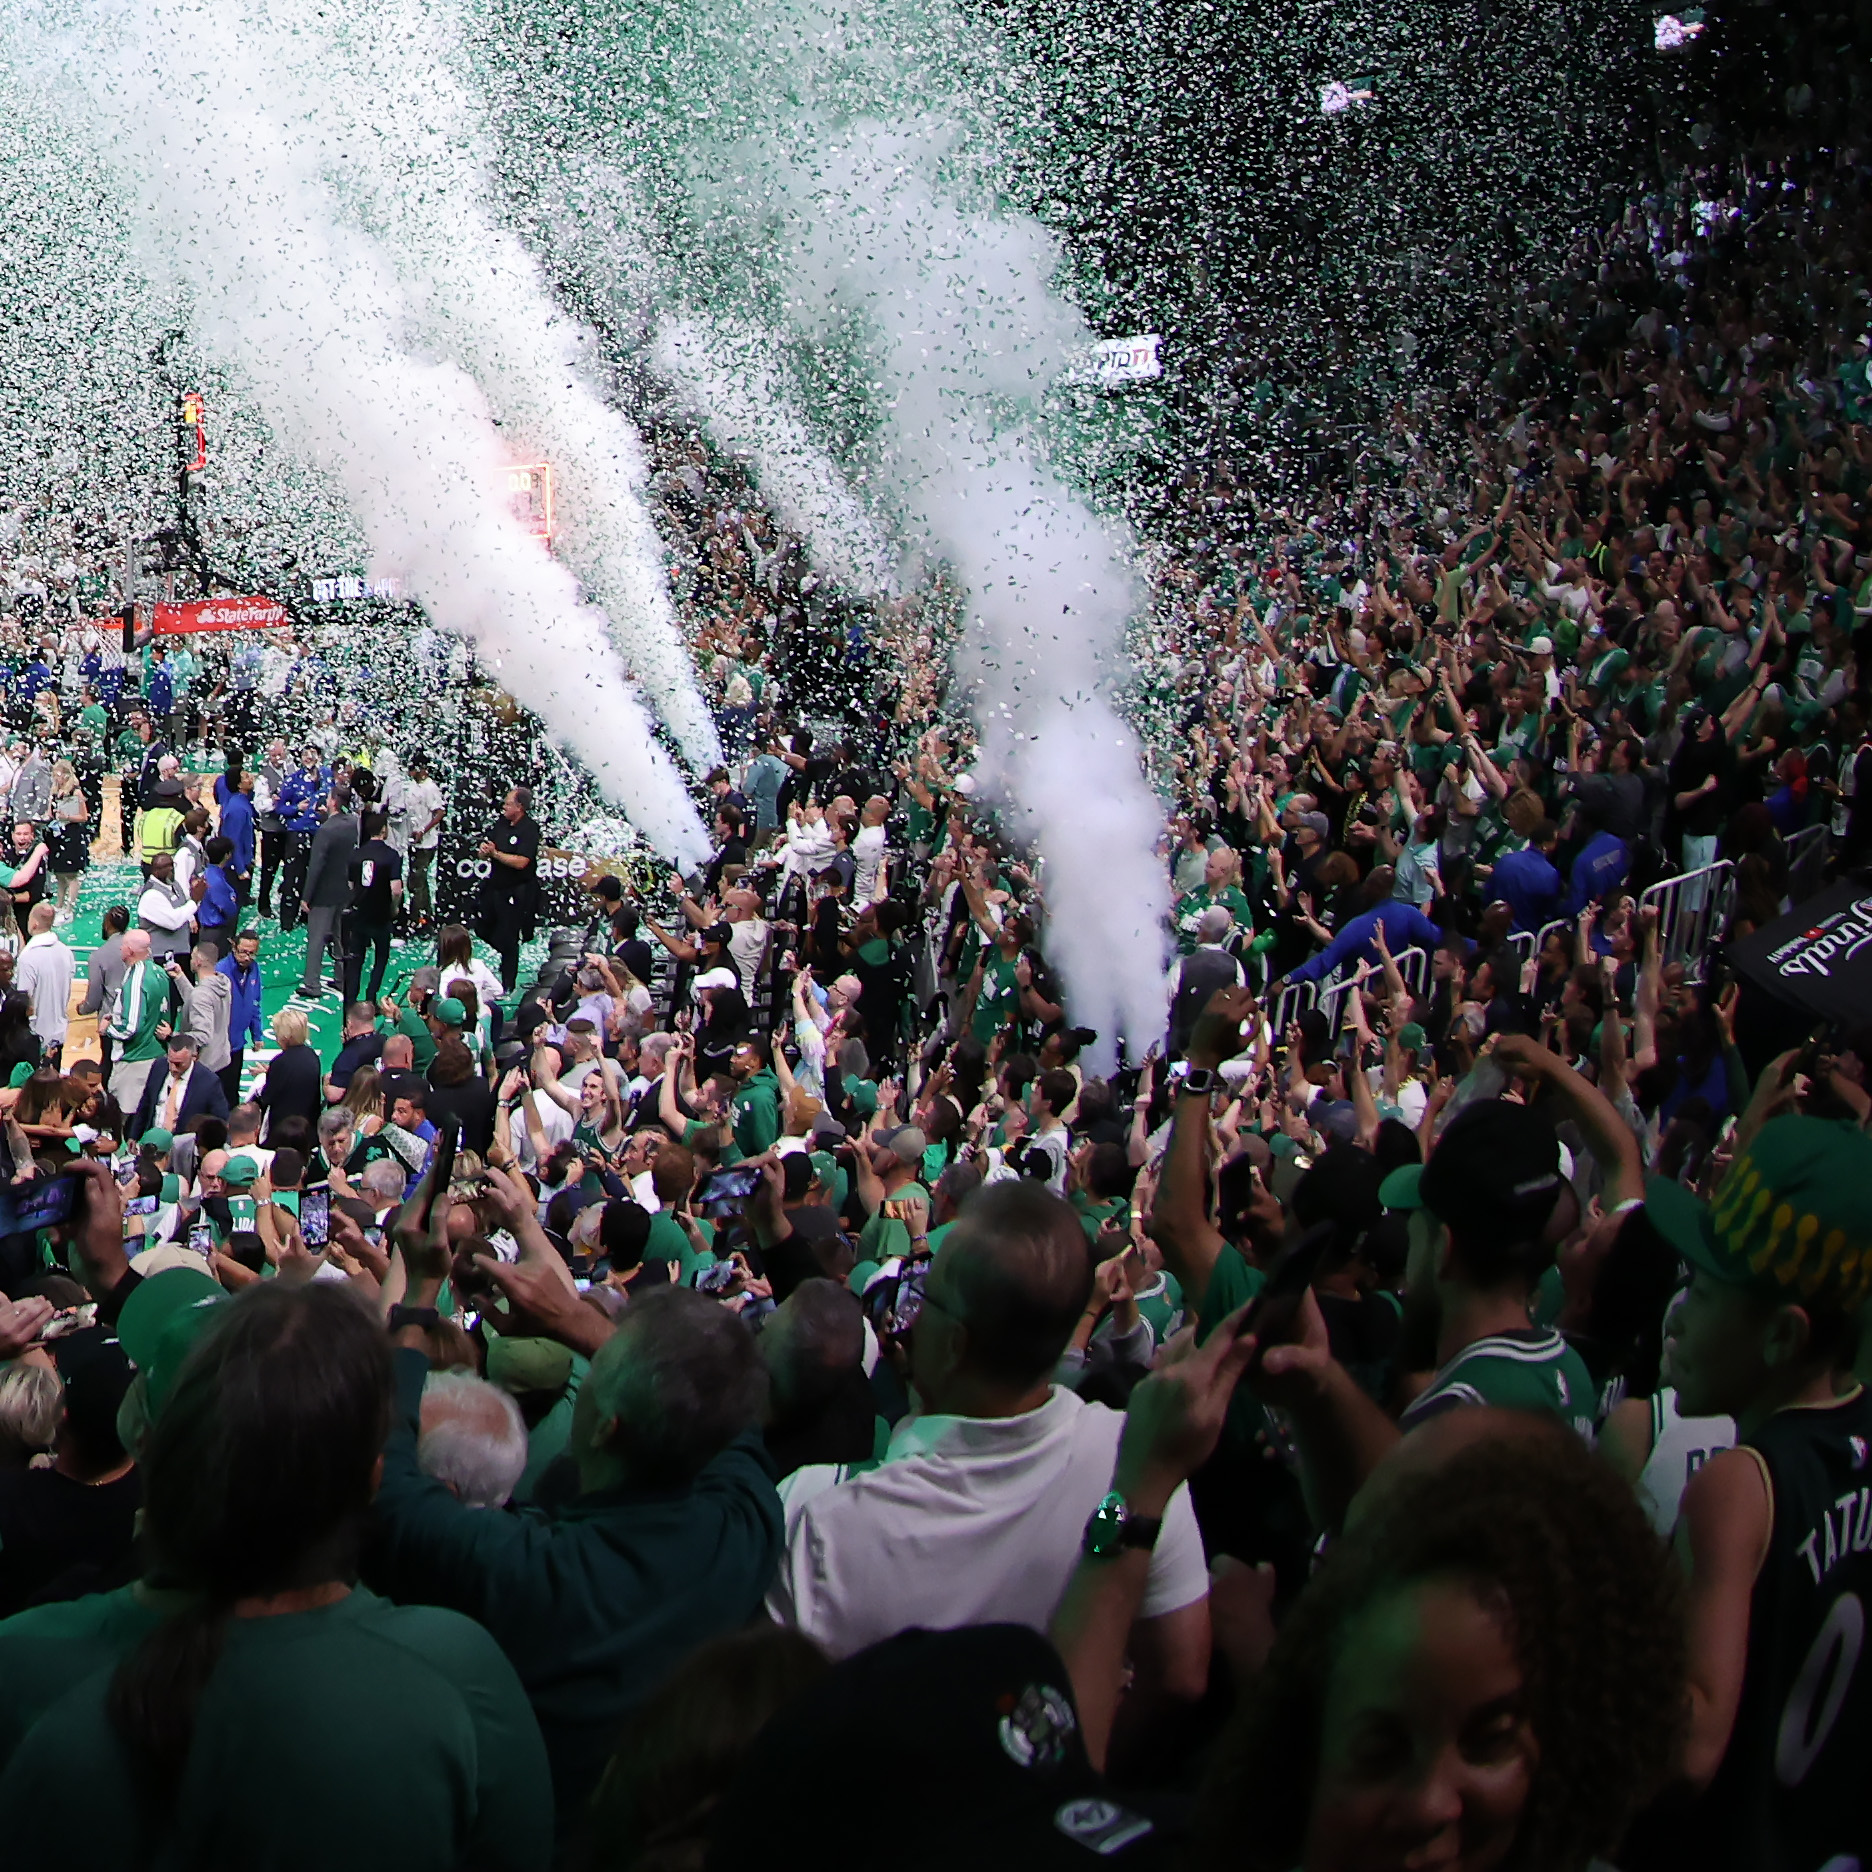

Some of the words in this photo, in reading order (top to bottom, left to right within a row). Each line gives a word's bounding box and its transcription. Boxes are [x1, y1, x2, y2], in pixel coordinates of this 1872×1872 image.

[312, 578, 336, 600] GET
[231, 1217, 257, 1233] LIDA
[1774, 1590, 1866, 1790] 0
